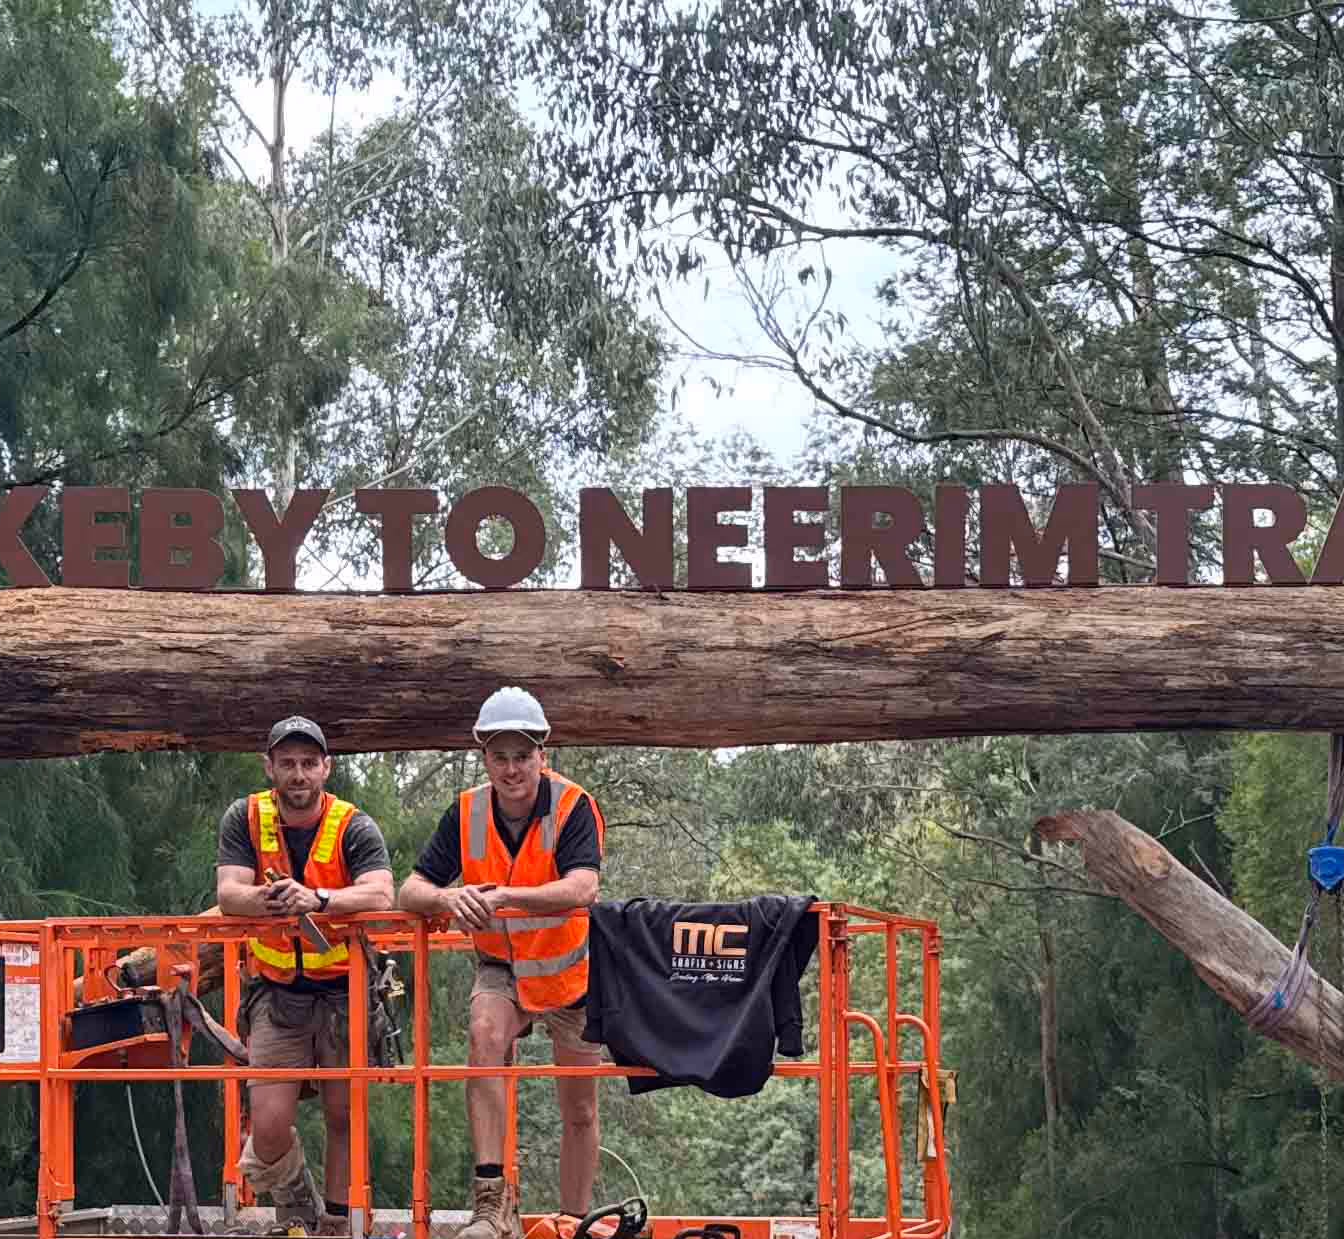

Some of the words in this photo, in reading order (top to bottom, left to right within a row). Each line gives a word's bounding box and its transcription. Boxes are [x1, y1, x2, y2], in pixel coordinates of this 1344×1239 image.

[355, 485, 547, 592] TO
[580, 483, 1098, 588] NEERIM
[673, 921, 749, 956] MC
